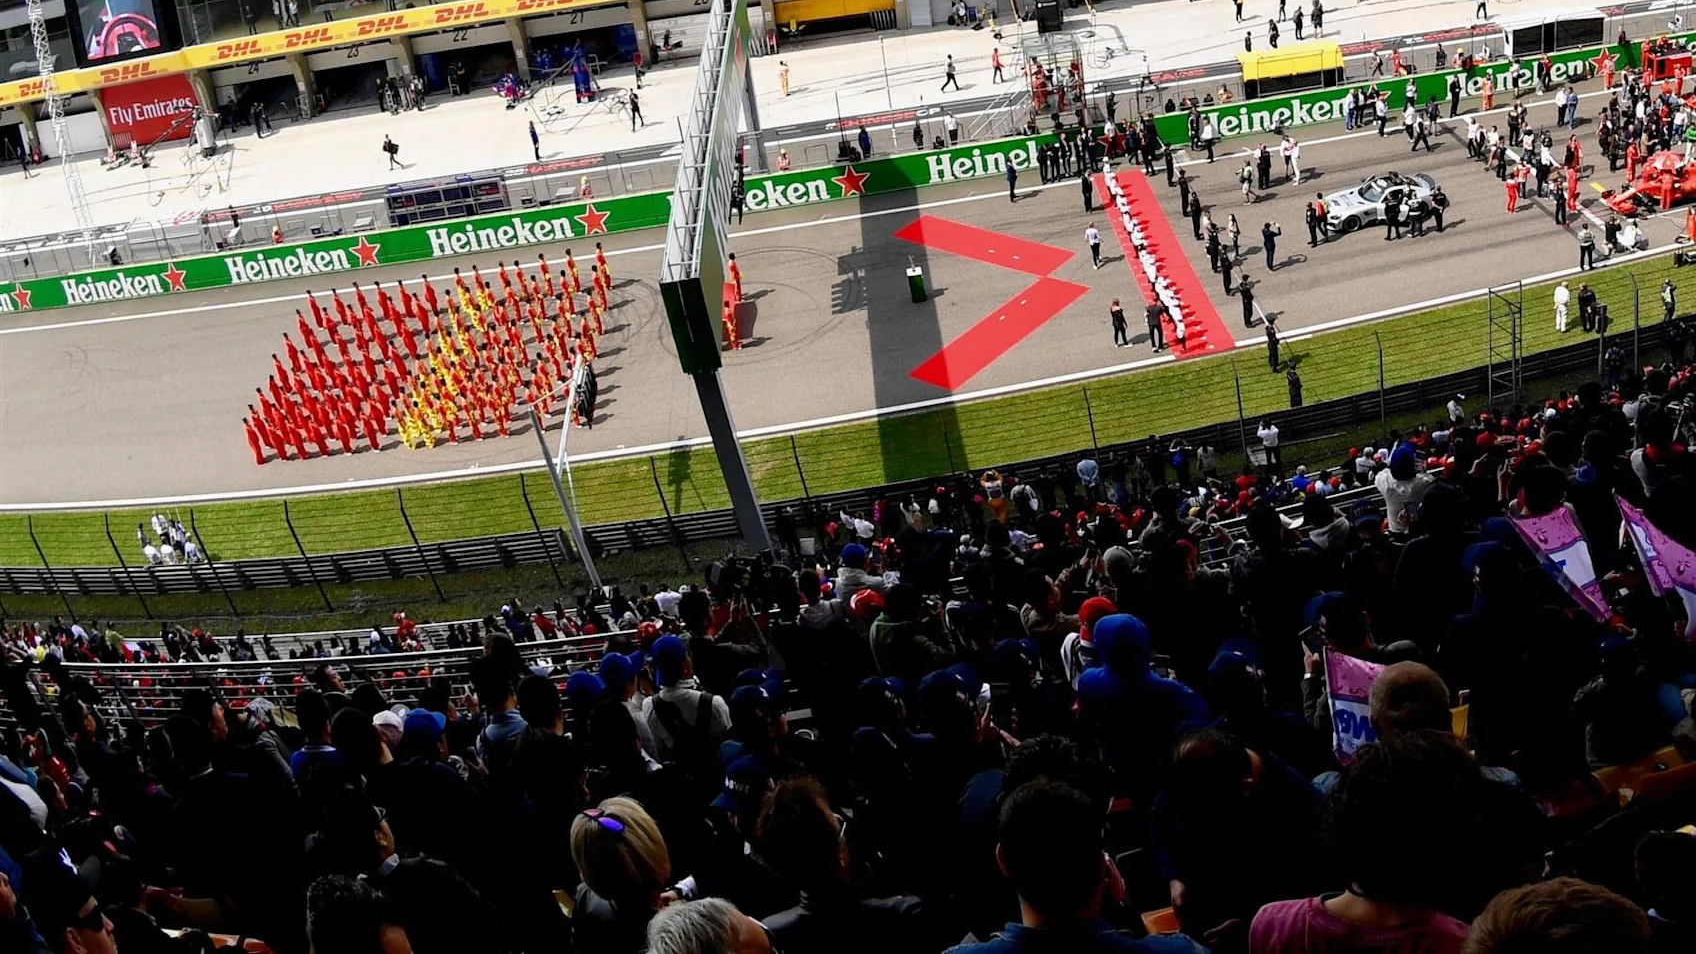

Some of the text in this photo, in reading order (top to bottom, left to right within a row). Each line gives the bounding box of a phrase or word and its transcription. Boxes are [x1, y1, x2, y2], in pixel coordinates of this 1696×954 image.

[434, 2, 489, 23] DHL
[571, 11, 583, 24] 21
[357, 15, 409, 35] DHL
[285, 28, 334, 48] DHL
[453, 29, 467, 42] 22
[217, 40, 263, 60] DHL
[347, 46, 359, 58] 23
[100, 62, 158, 84] DHL
[248, 63, 259, 74] 24
[109, 96, 193, 126] Fly Emirates
[425, 217, 575, 258] Heineken
[223, 247, 351, 284] Heineken
[60, 270, 164, 305] Heineken
